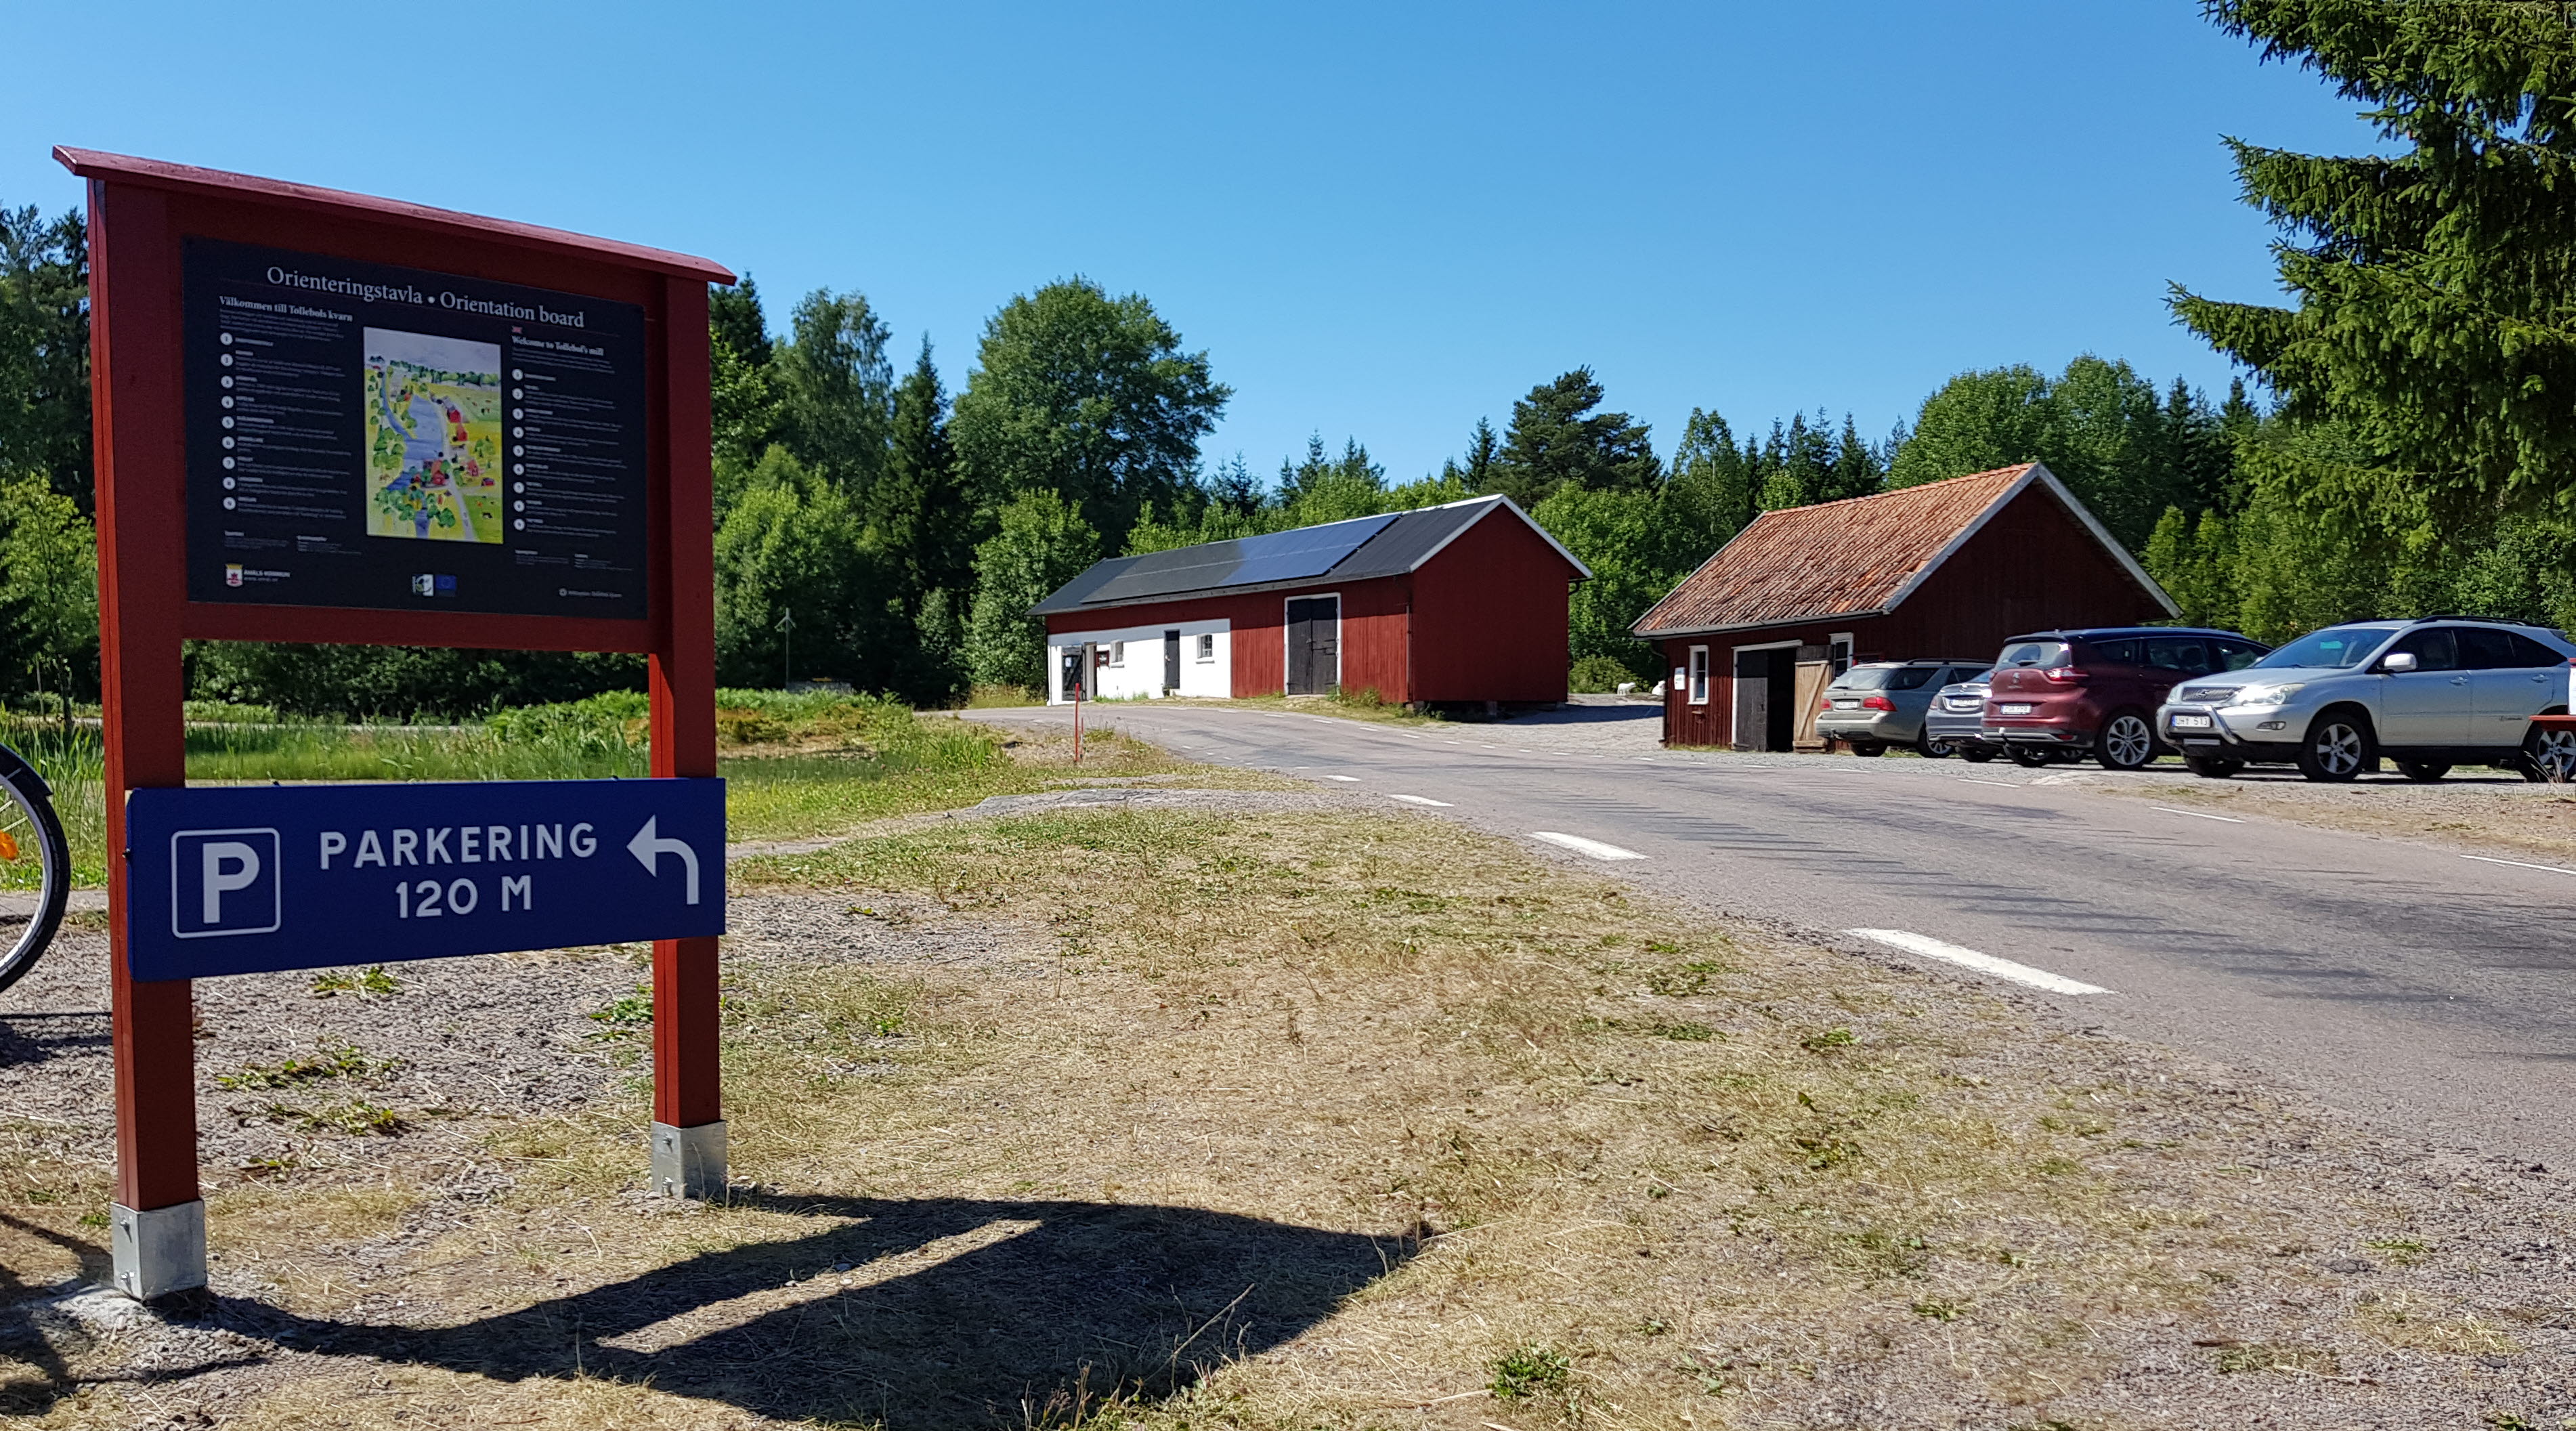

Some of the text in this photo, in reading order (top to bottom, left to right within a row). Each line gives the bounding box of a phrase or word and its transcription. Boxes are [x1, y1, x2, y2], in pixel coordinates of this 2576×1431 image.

[219, 295, 273, 311] Välkommen
[274, 303, 288, 314] till
[328, 310, 353, 322] kvarn
[267, 266, 584, 328] Orienteringstavla Orientation board
[320, 822, 597, 870] PARKERING
[202, 842, 260, 924] P
[395, 875, 531, 918] 120 M
